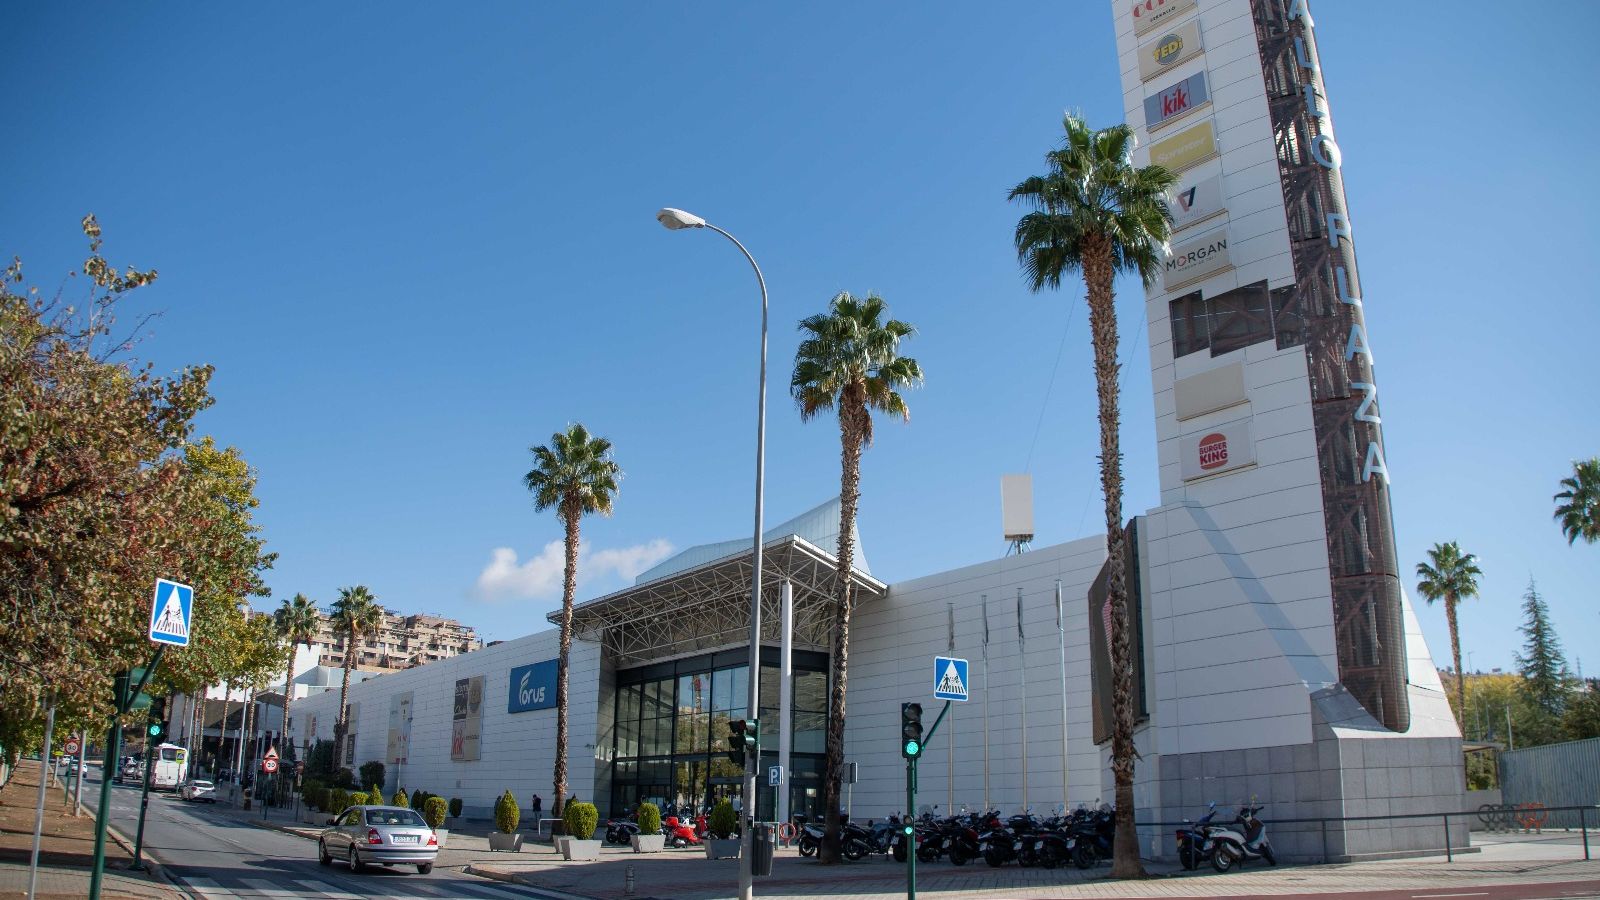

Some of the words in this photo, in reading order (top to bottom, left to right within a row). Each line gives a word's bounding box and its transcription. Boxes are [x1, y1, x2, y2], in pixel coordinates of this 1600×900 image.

[1163, 85, 1187, 117] kik
[1166, 239, 1227, 271] MORGAN
[1328, 213, 1390, 485] PLAZA
[1199, 441, 1227, 455] BURGER
[1200, 449, 1228, 465] KING
[770, 768, 779, 784] P
